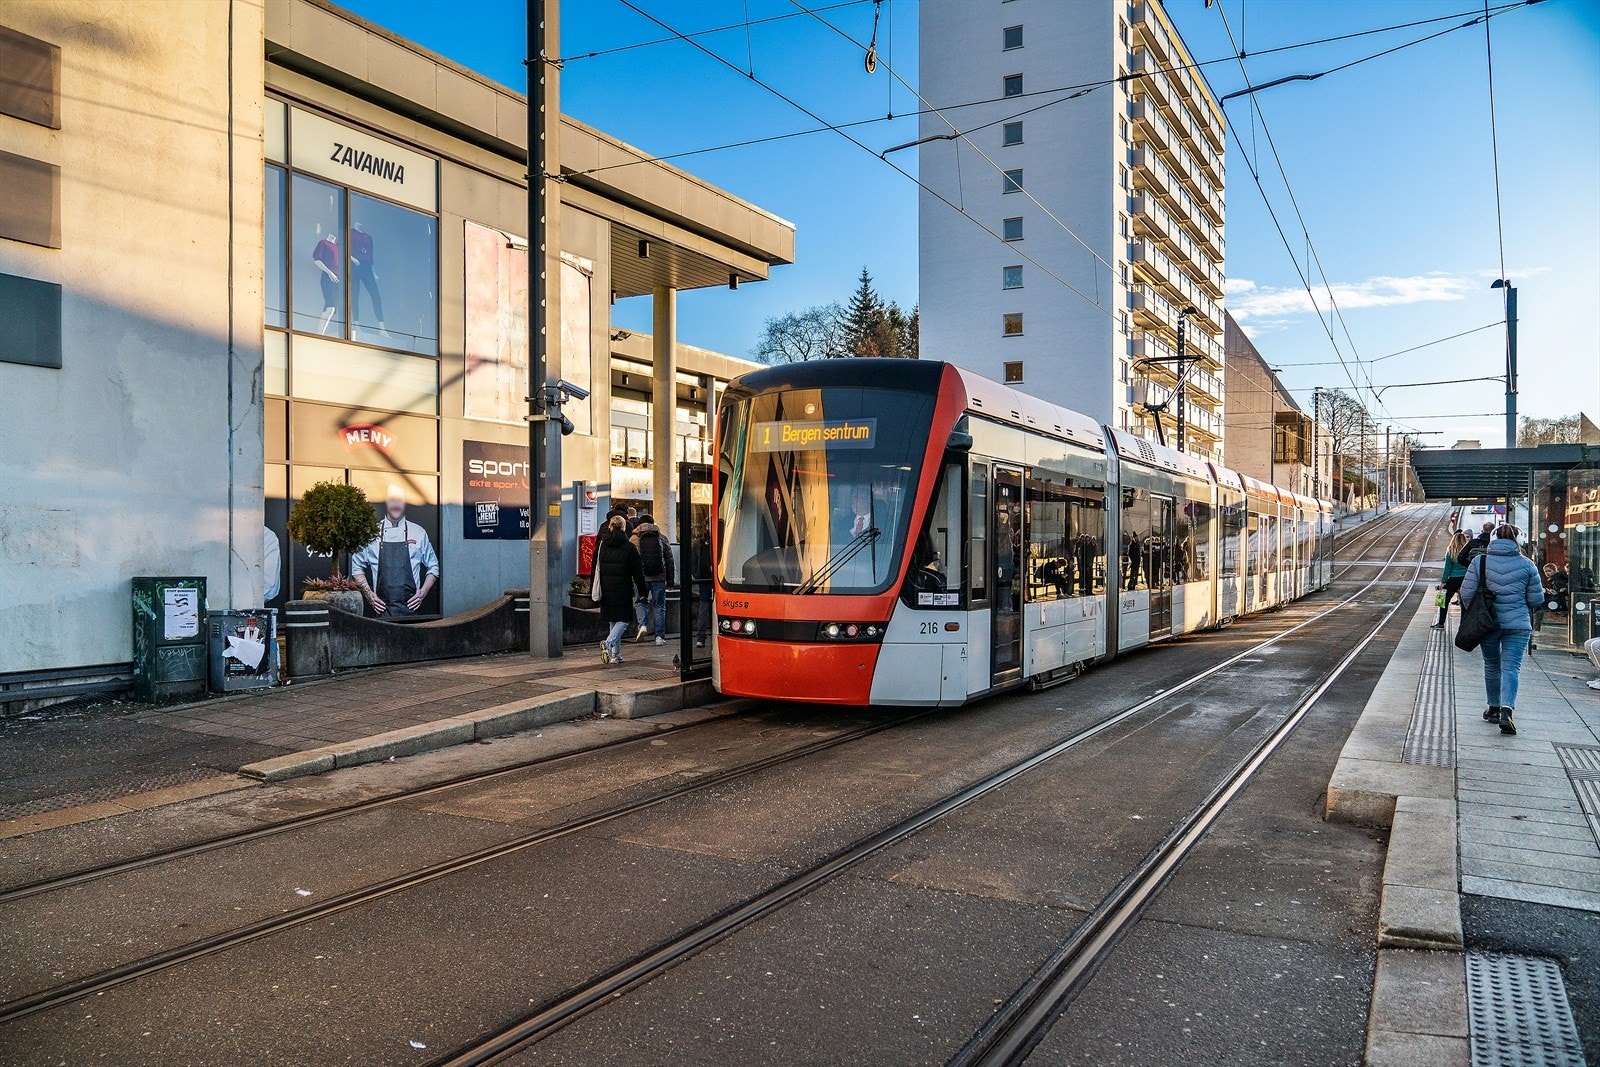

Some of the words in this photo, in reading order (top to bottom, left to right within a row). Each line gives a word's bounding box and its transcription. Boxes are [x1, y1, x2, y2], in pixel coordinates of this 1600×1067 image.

[330, 142, 405, 185] ZAVANNA
[346, 429, 392, 447] MENY
[763, 427, 770, 444] 1
[782, 424, 821, 445] Bergen
[823, 422, 869, 440] sentrum
[469, 459, 529, 478] sport
[469, 480, 491, 488] ekte
[723, 599, 743, 609] skyss
[920, 622, 938, 634] 216
